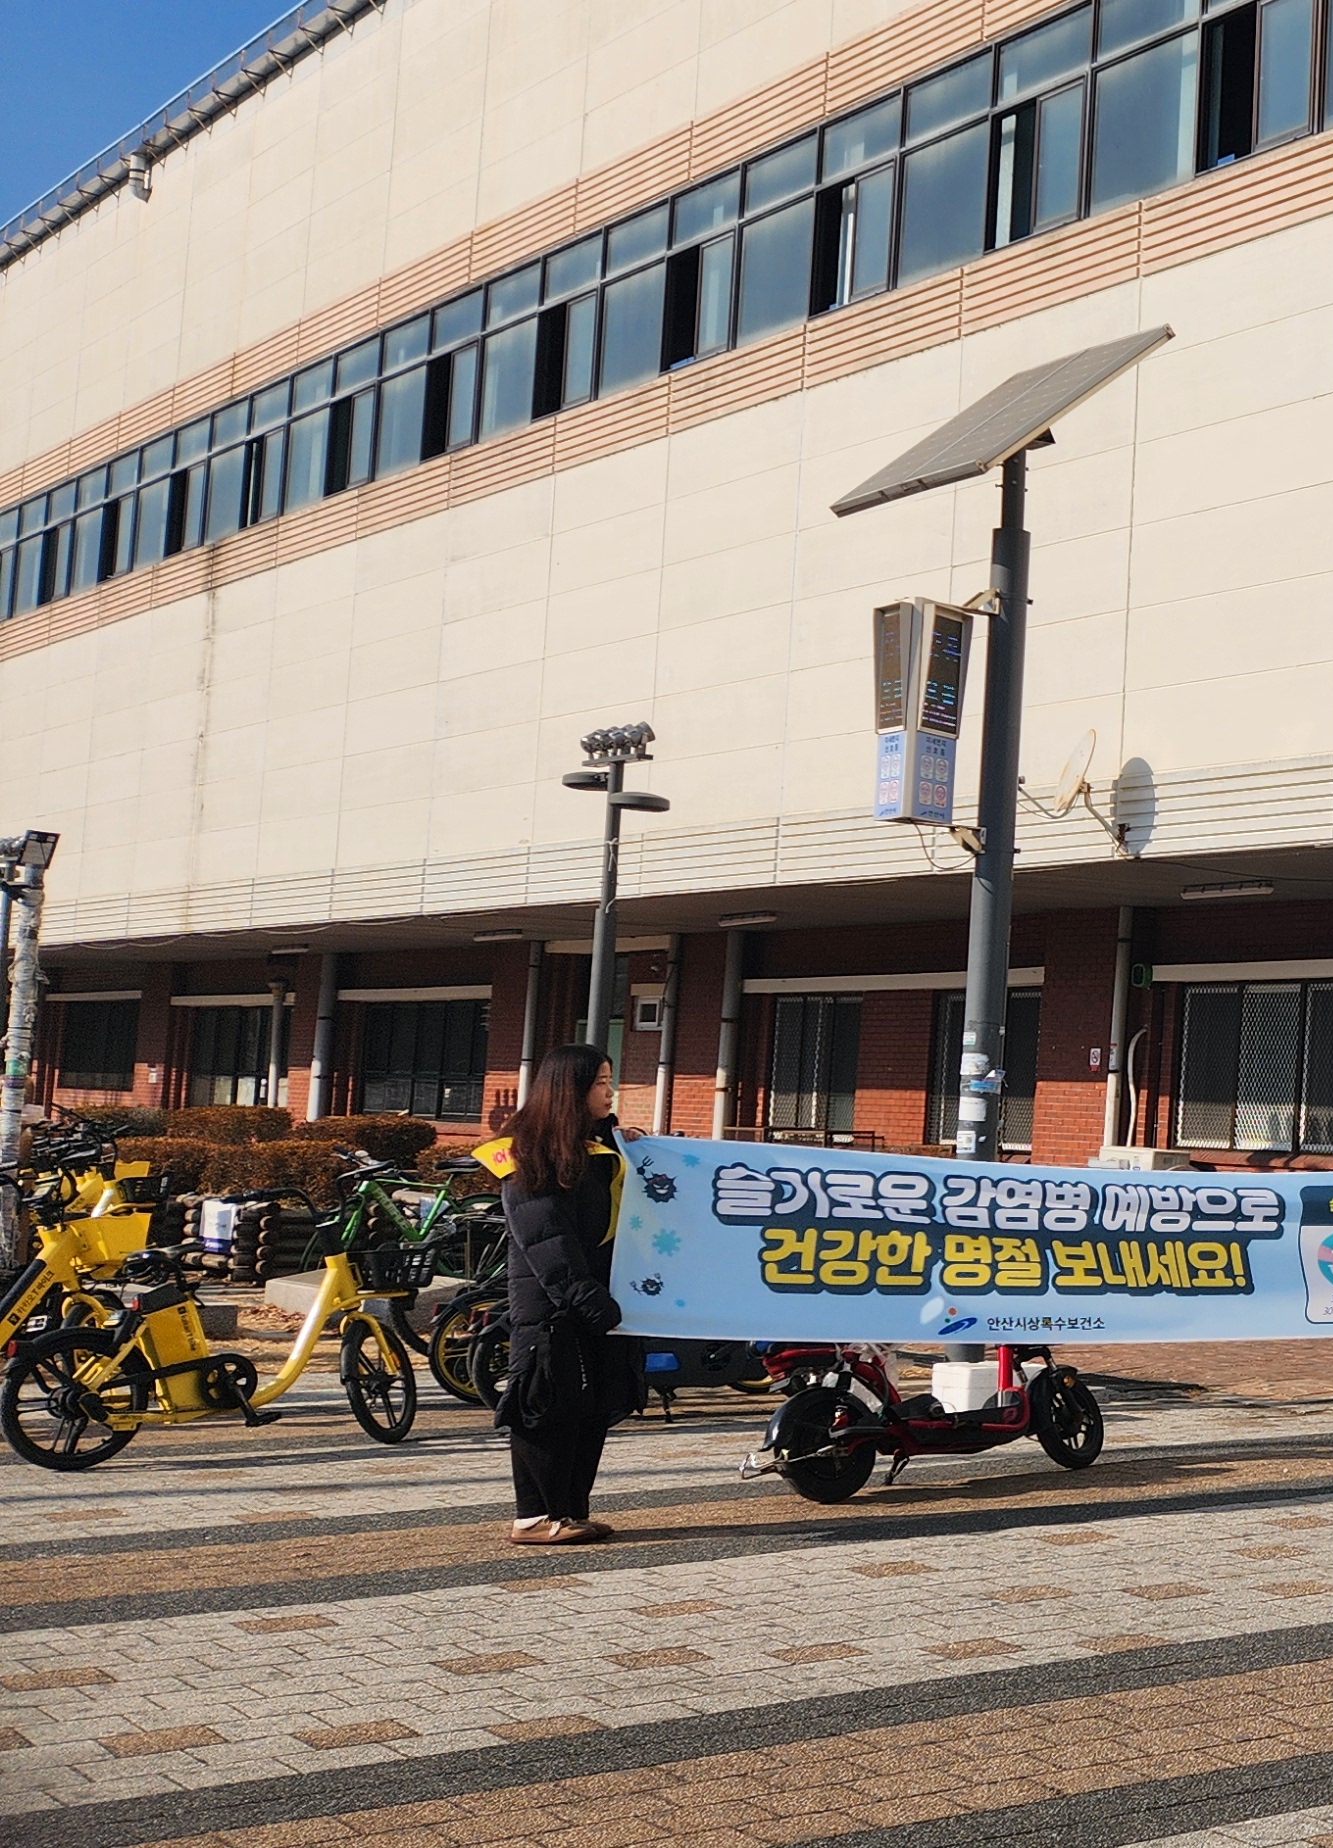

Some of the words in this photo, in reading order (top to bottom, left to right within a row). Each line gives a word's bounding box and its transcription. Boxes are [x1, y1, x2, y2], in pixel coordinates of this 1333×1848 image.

[716, 1165, 930, 1225] 슬기로운
[943, 1178, 1090, 1232] 감염병
[1102, 1186, 1279, 1232] 예방으로
[761, 1230, 931, 1288] 건강한
[944, 1236, 1041, 1288] 명절
[1054, 1241, 1244, 1289] 보내세요!
[986, 1315, 1106, 1333] 안산시상록수보건소
